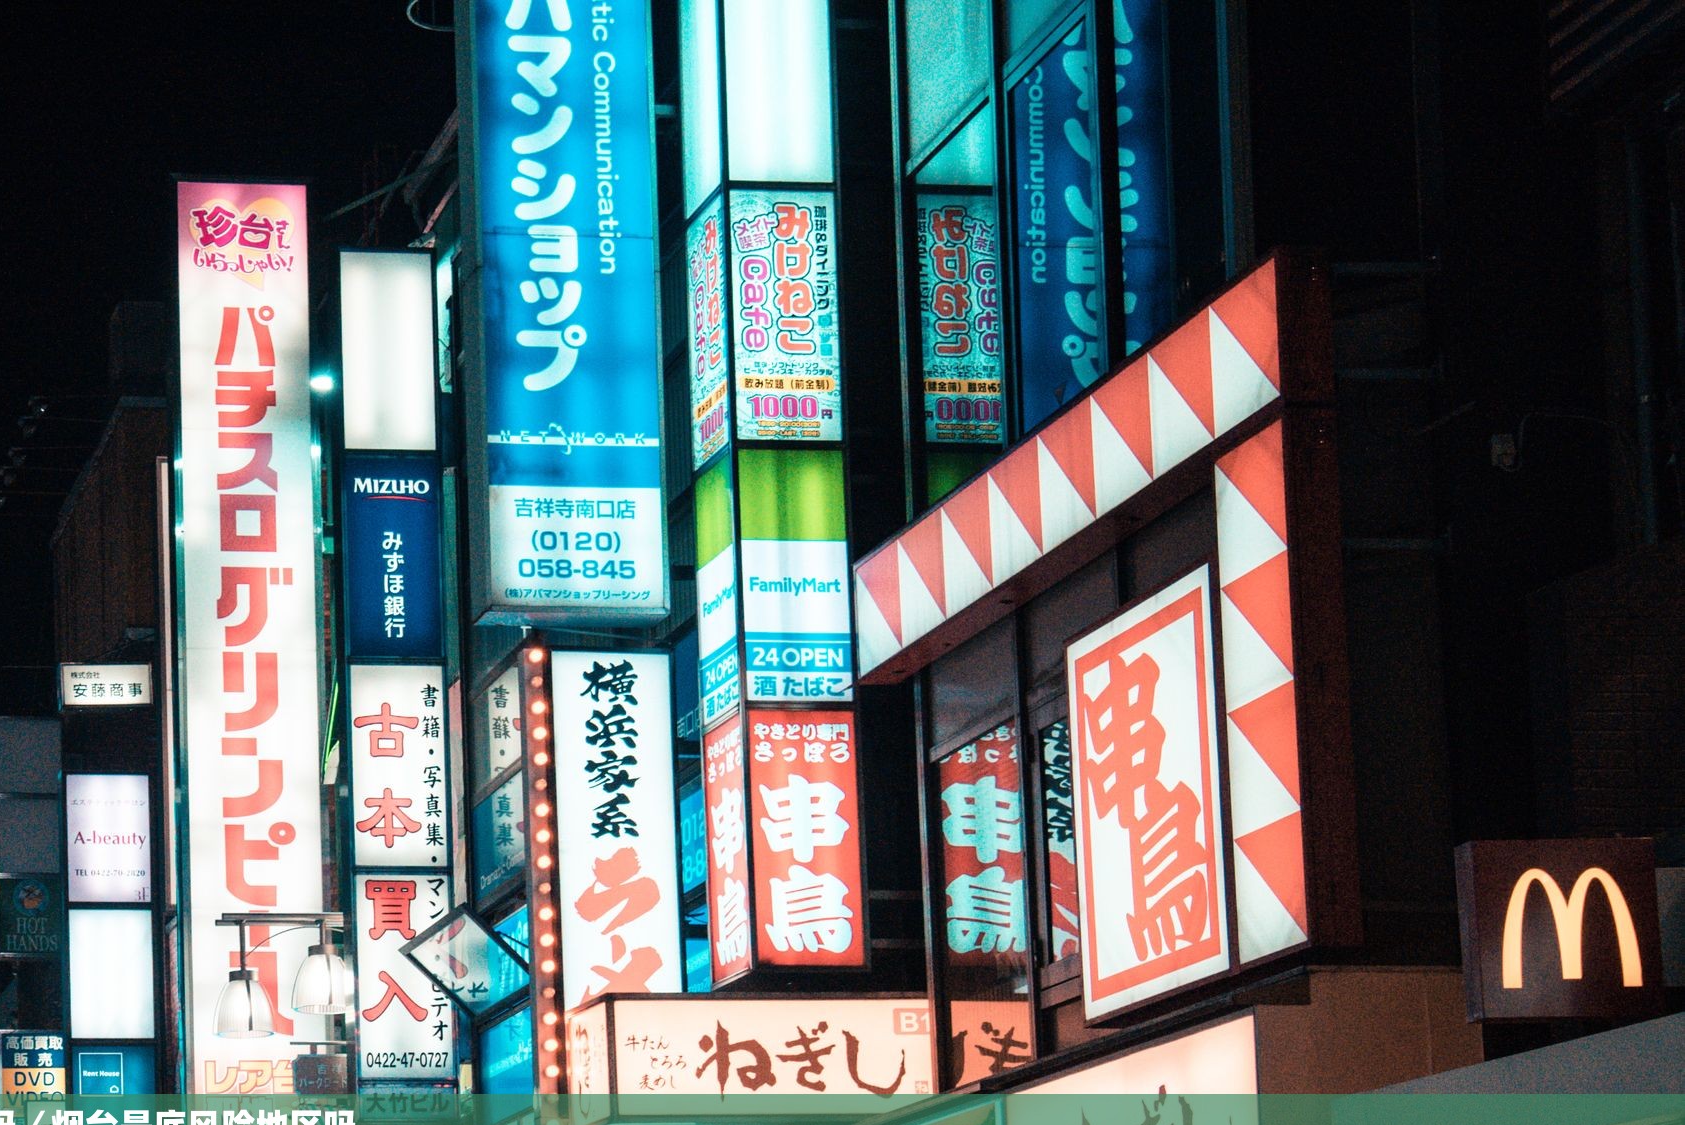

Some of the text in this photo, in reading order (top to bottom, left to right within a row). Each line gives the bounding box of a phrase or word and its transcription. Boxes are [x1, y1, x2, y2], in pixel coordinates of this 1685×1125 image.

[591, 50, 616, 275] Communication
[194, 248, 295, 275] いらっしゃい!
[773, 203, 816, 354] みけねこ
[744, 377, 785, 390] 飲み放題
[747, 396, 833, 421] 1000円
[353, 477, 430, 495] MIZUHO
[513, 497, 636, 519] 吉祥寺南口店
[530, 531, 621, 554] (0120)
[517, 558, 637, 582] 058-845
[381, 530, 407, 638] みずほ銀行
[749, 576, 842, 597] FamilyMart
[752, 648, 845, 668] 24 OPEN
[72, 683, 143, 699] 安藤商事
[754, 675, 846, 697] 酒 たばこ
[579, 659, 642, 839] 横浜家系
[754, 741, 852, 764] さっぽろ
[353, 702, 422, 849] 古本
[1082, 651, 1212, 962] 串鳥
[74, 831, 147, 850] A-beauty
[74, 869, 89, 877] TEL
[758, 774, 854, 954] 串鳥
[16, 917, 47, 935] HOT
[5, 935, 59, 953] HANDS
[361, 879, 429, 1023] 買入
[900, 1010, 930, 1034] B1
[624, 1034, 671, 1052] 牛たん
[14, 1053, 53, 1067] 販売
[366, 1052, 450, 1070] 0422-47-0727
[649, 1054, 688, 1070] とろろ
[695, 1018, 907, 1103] ねぎし
[15, 1071, 56, 1087] DVD
[99, 1070, 121, 1078] House
[638, 1073, 677, 1091] 麦めし
